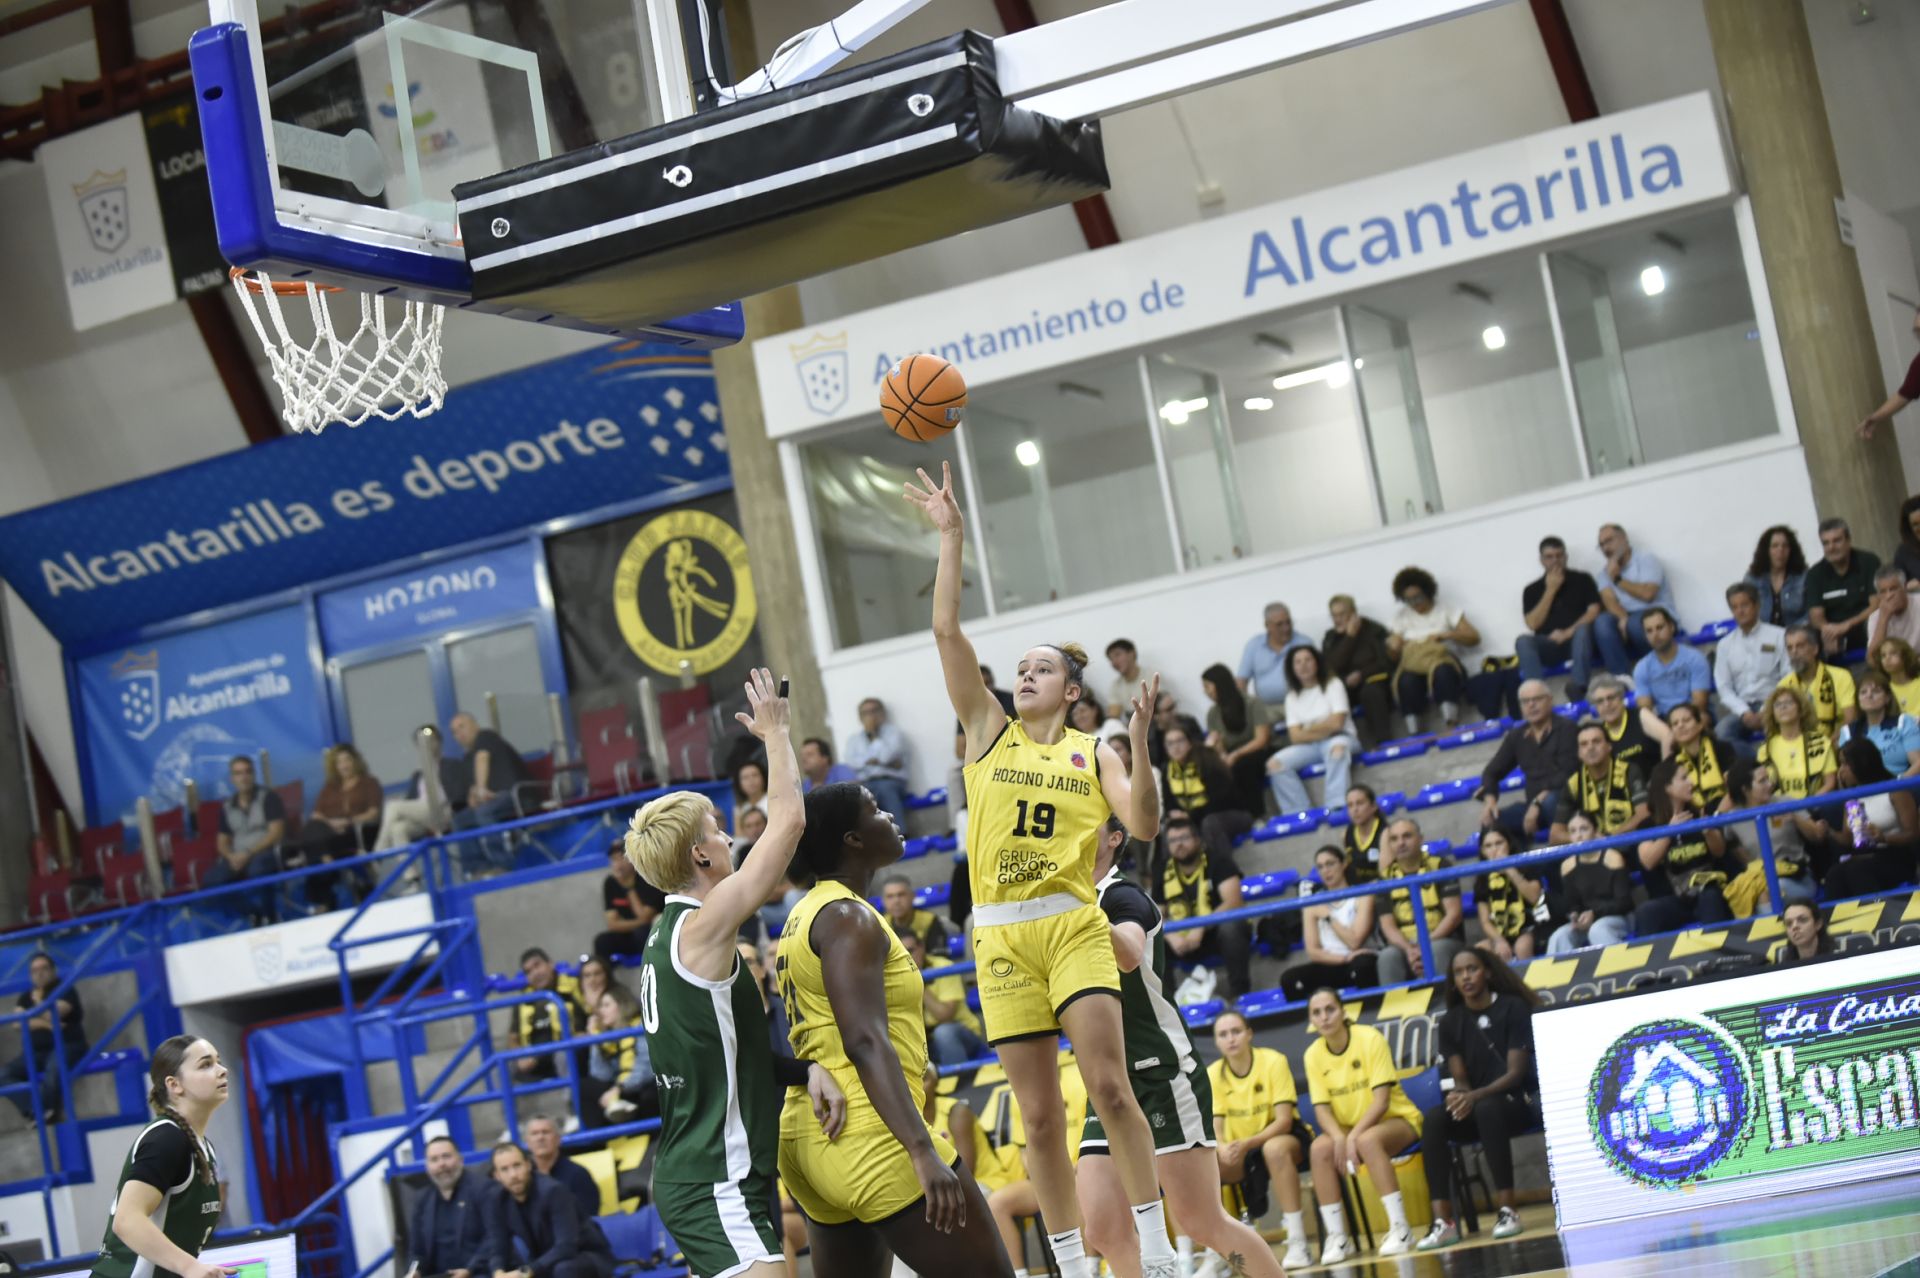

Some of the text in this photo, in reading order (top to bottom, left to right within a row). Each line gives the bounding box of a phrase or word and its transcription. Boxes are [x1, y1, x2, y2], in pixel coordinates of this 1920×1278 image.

[160, 150, 205, 180] LOCA
[71, 246, 163, 287] Alcantarilla
[873, 133, 1684, 385] Antamiento de Alcantarilla
[40, 417, 625, 597] Alcantarilla es deporte
[165, 670, 291, 722] Alcantarilla
[992, 767, 1091, 797] HOZONO JAIRIS
[1012, 799, 1057, 840] 19
[998, 871, 1047, 885] GLOBA
[1764, 1006, 1819, 1039] La
[1760, 1044, 1920, 1152] Esca
